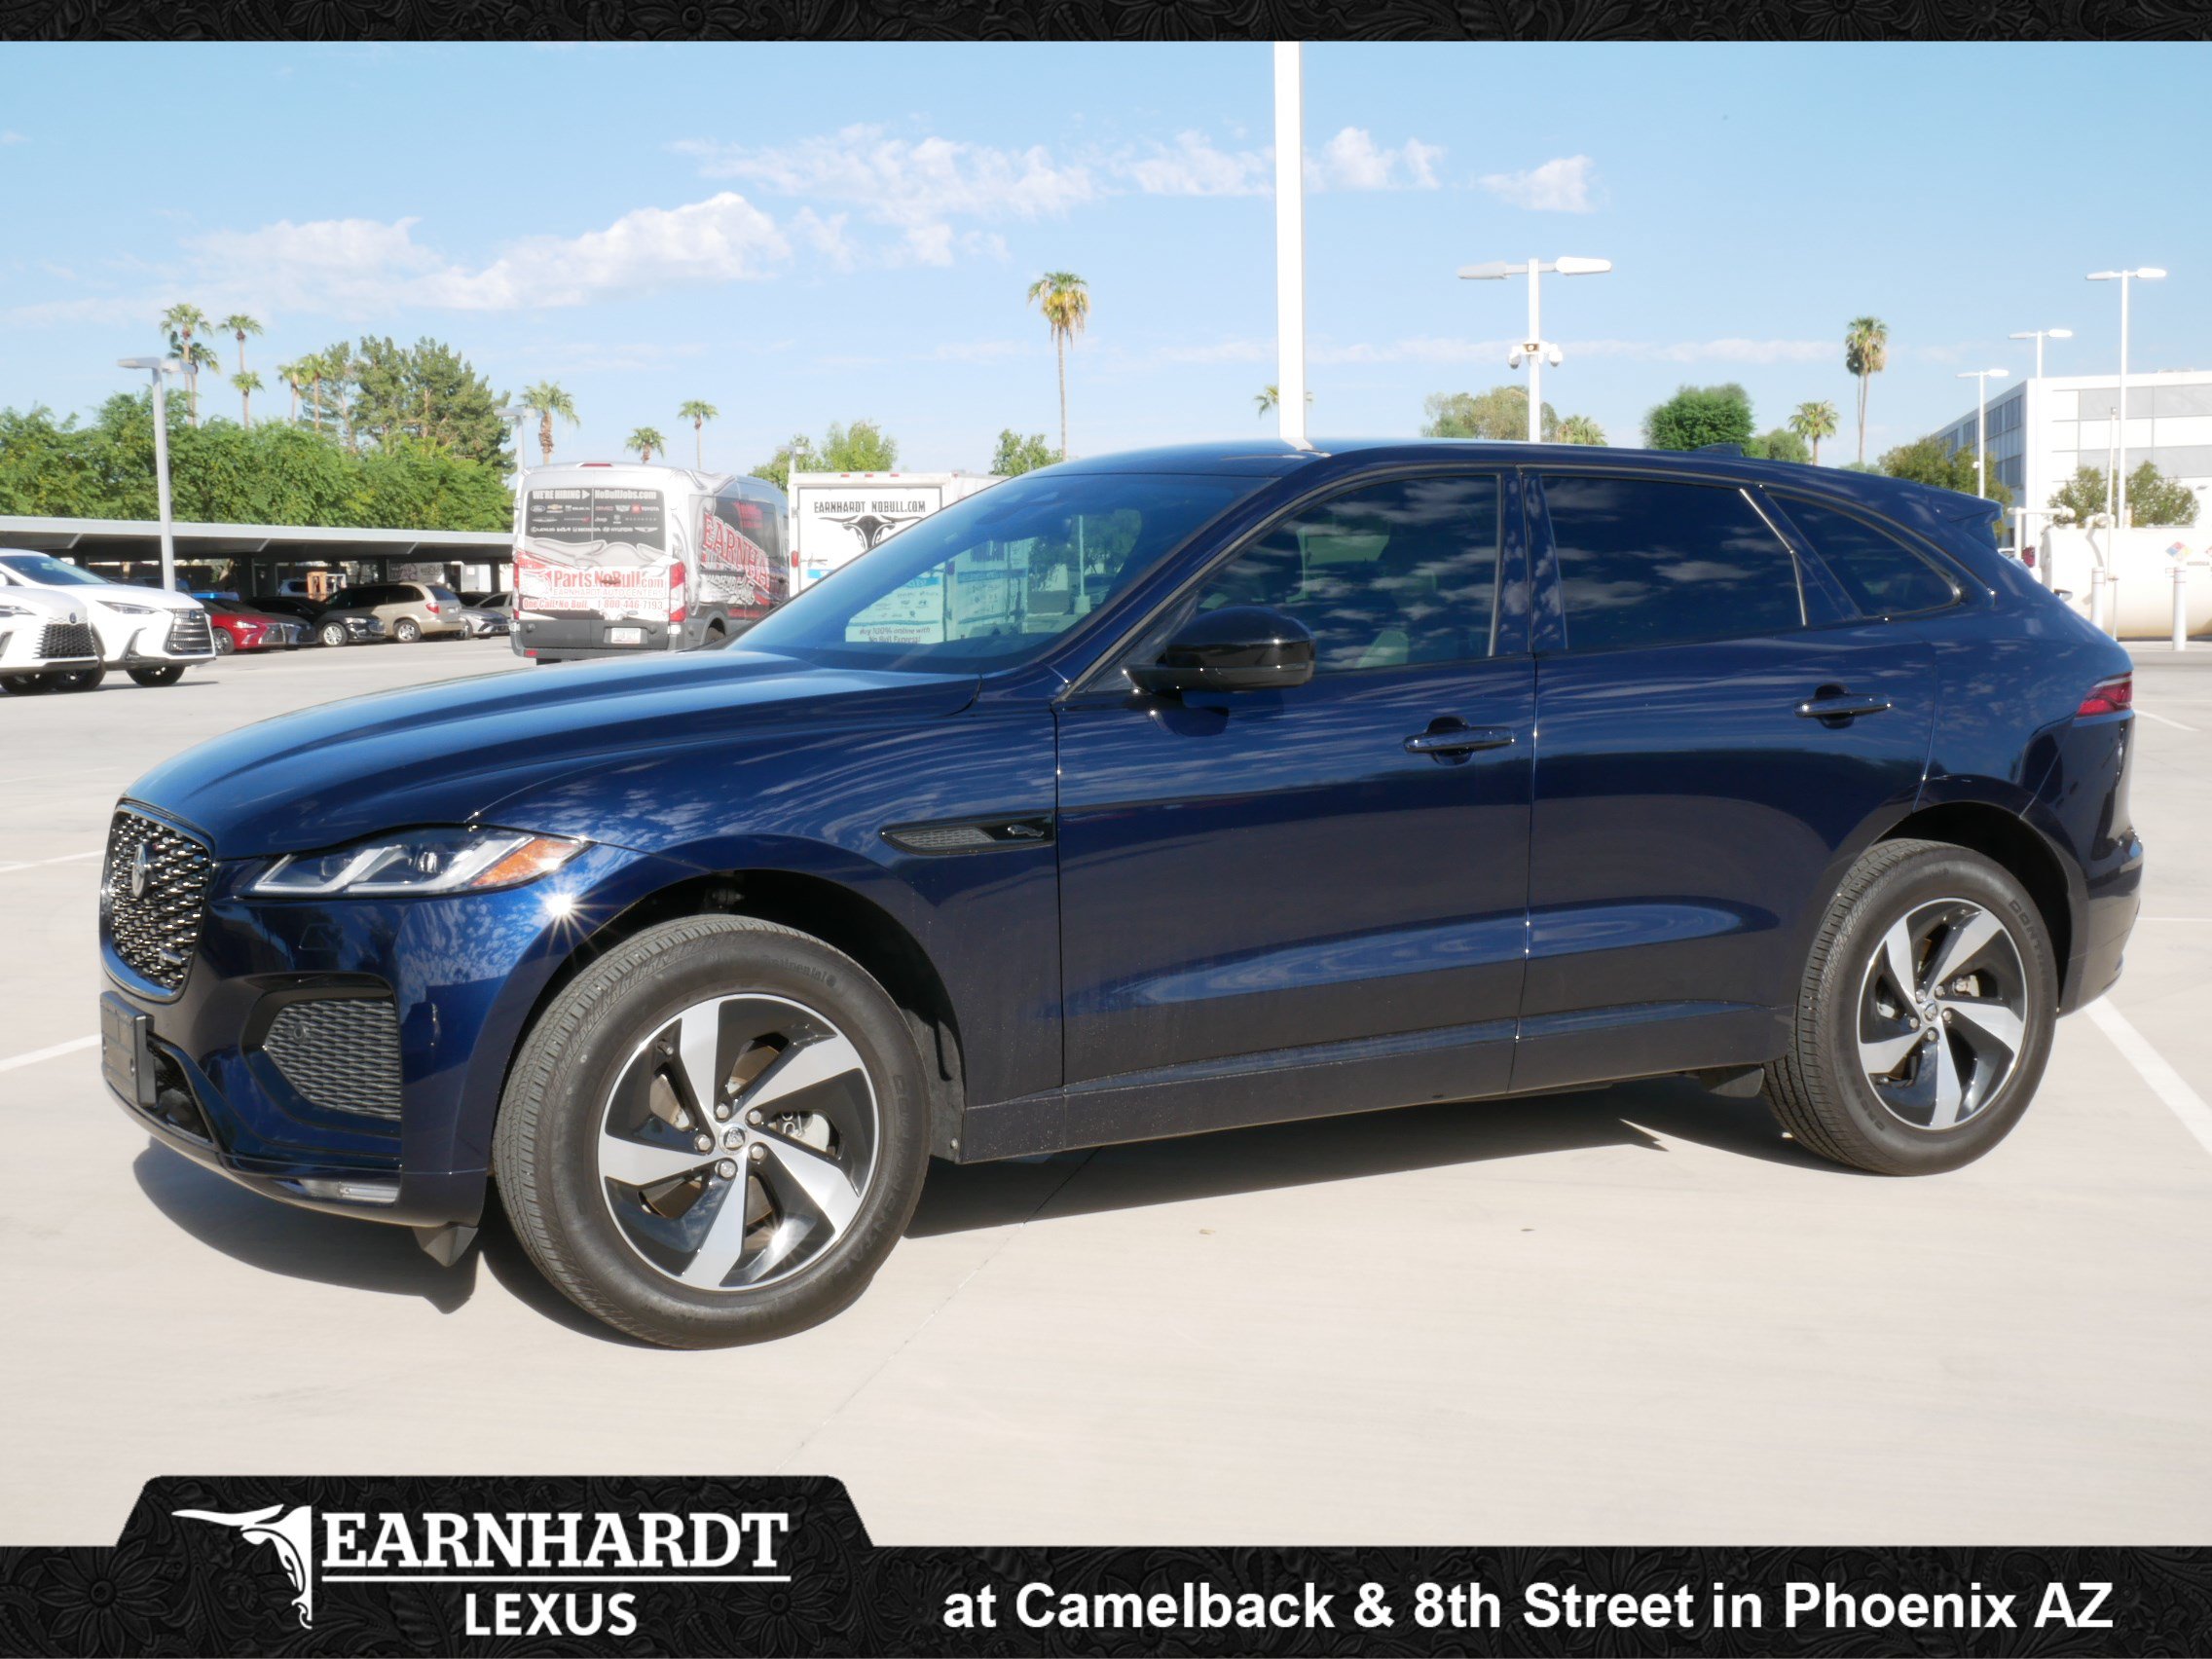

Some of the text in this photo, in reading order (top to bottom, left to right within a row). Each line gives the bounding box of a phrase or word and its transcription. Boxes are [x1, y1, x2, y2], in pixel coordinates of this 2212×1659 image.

[533, 490, 581, 499] WE'RE HIRING
[595, 490, 657, 499] NoBullJobs.com
[814, 500, 926, 513] EARNHARDT NOBULL.COM
[524, 598, 537, 608] One
[559, 599, 570, 608] No
